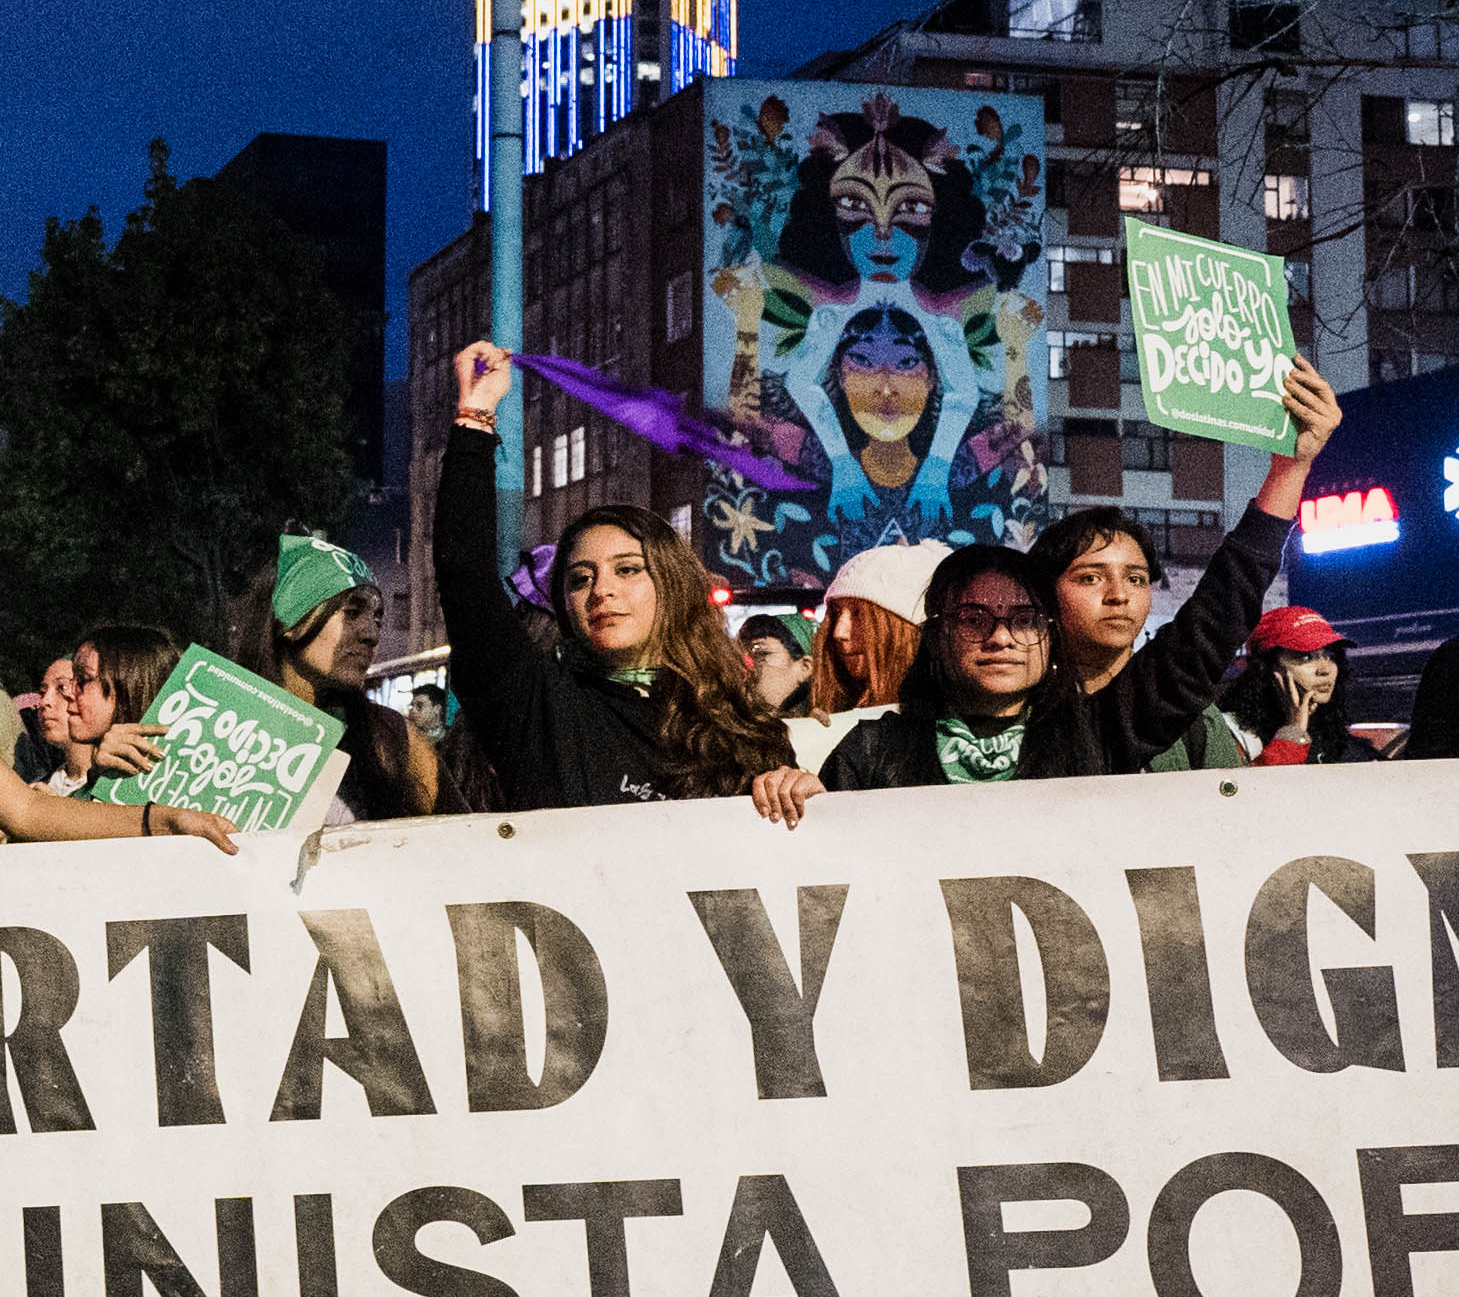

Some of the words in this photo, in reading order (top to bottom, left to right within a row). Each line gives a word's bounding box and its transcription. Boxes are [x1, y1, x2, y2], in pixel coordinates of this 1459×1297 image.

[1132, 259, 1168, 330] EN
[1165, 254, 1201, 311] MI
[1196, 253, 1283, 348] CUERPO
[1162, 291, 1251, 350] solo
[686, 884, 850, 1101] Y
